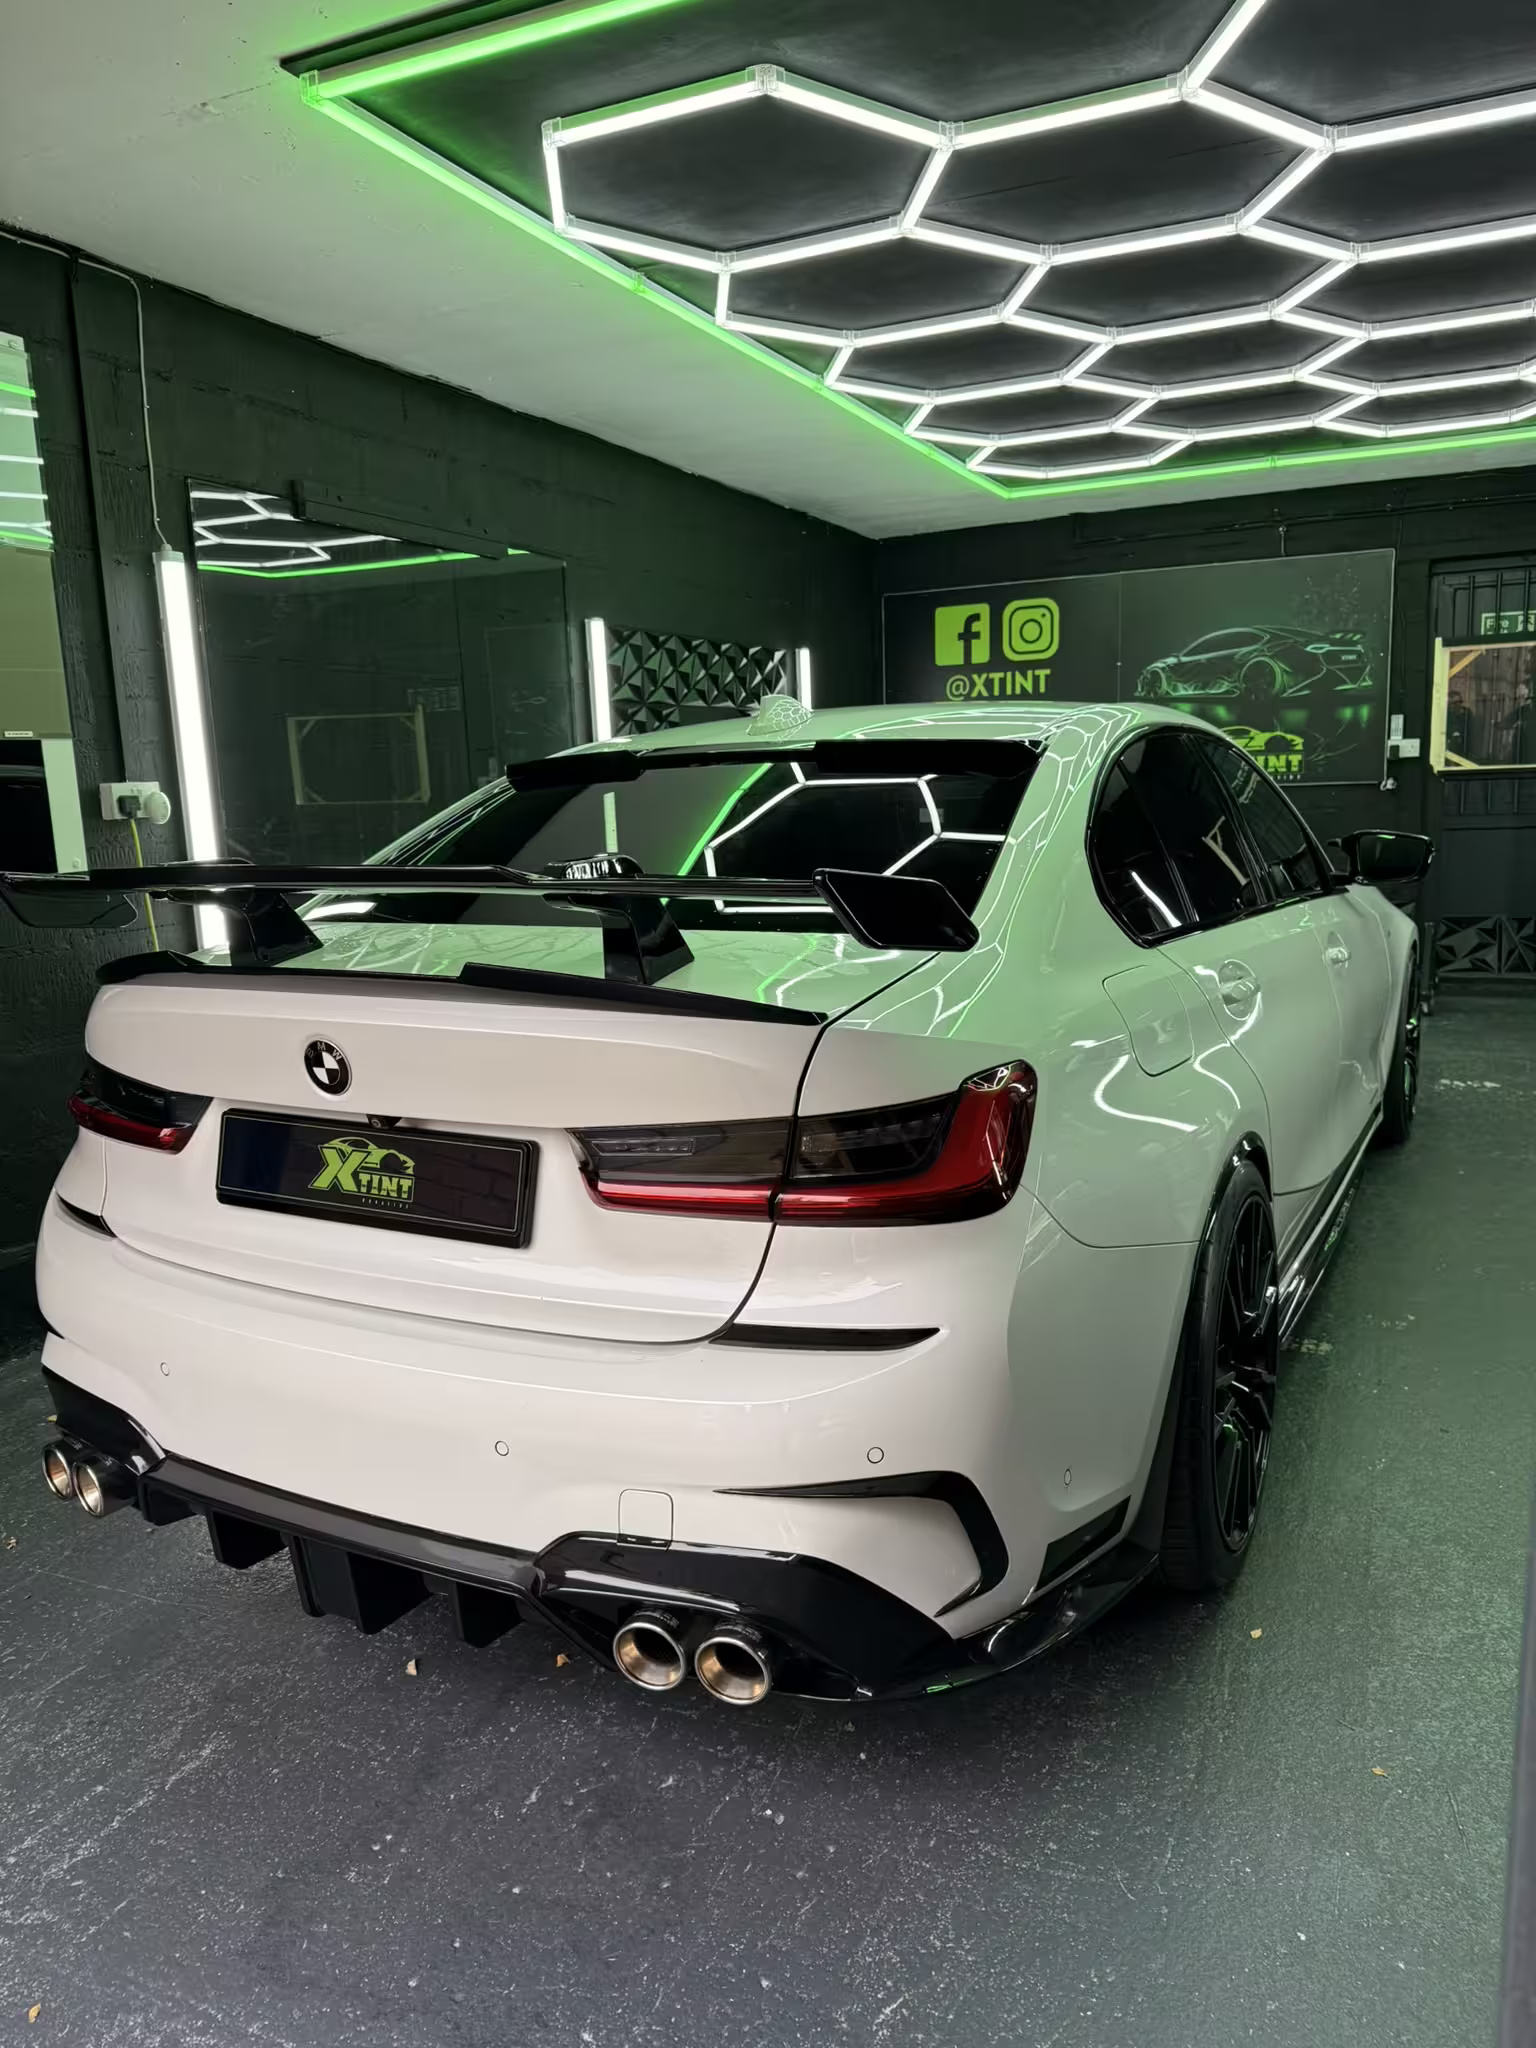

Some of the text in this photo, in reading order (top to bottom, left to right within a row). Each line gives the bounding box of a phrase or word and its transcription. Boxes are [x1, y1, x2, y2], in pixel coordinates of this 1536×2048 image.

[1486, 618, 1509, 629] Fre
[946, 669, 1051, 701] @XTINT
[306, 1041, 343, 1061] BMW
